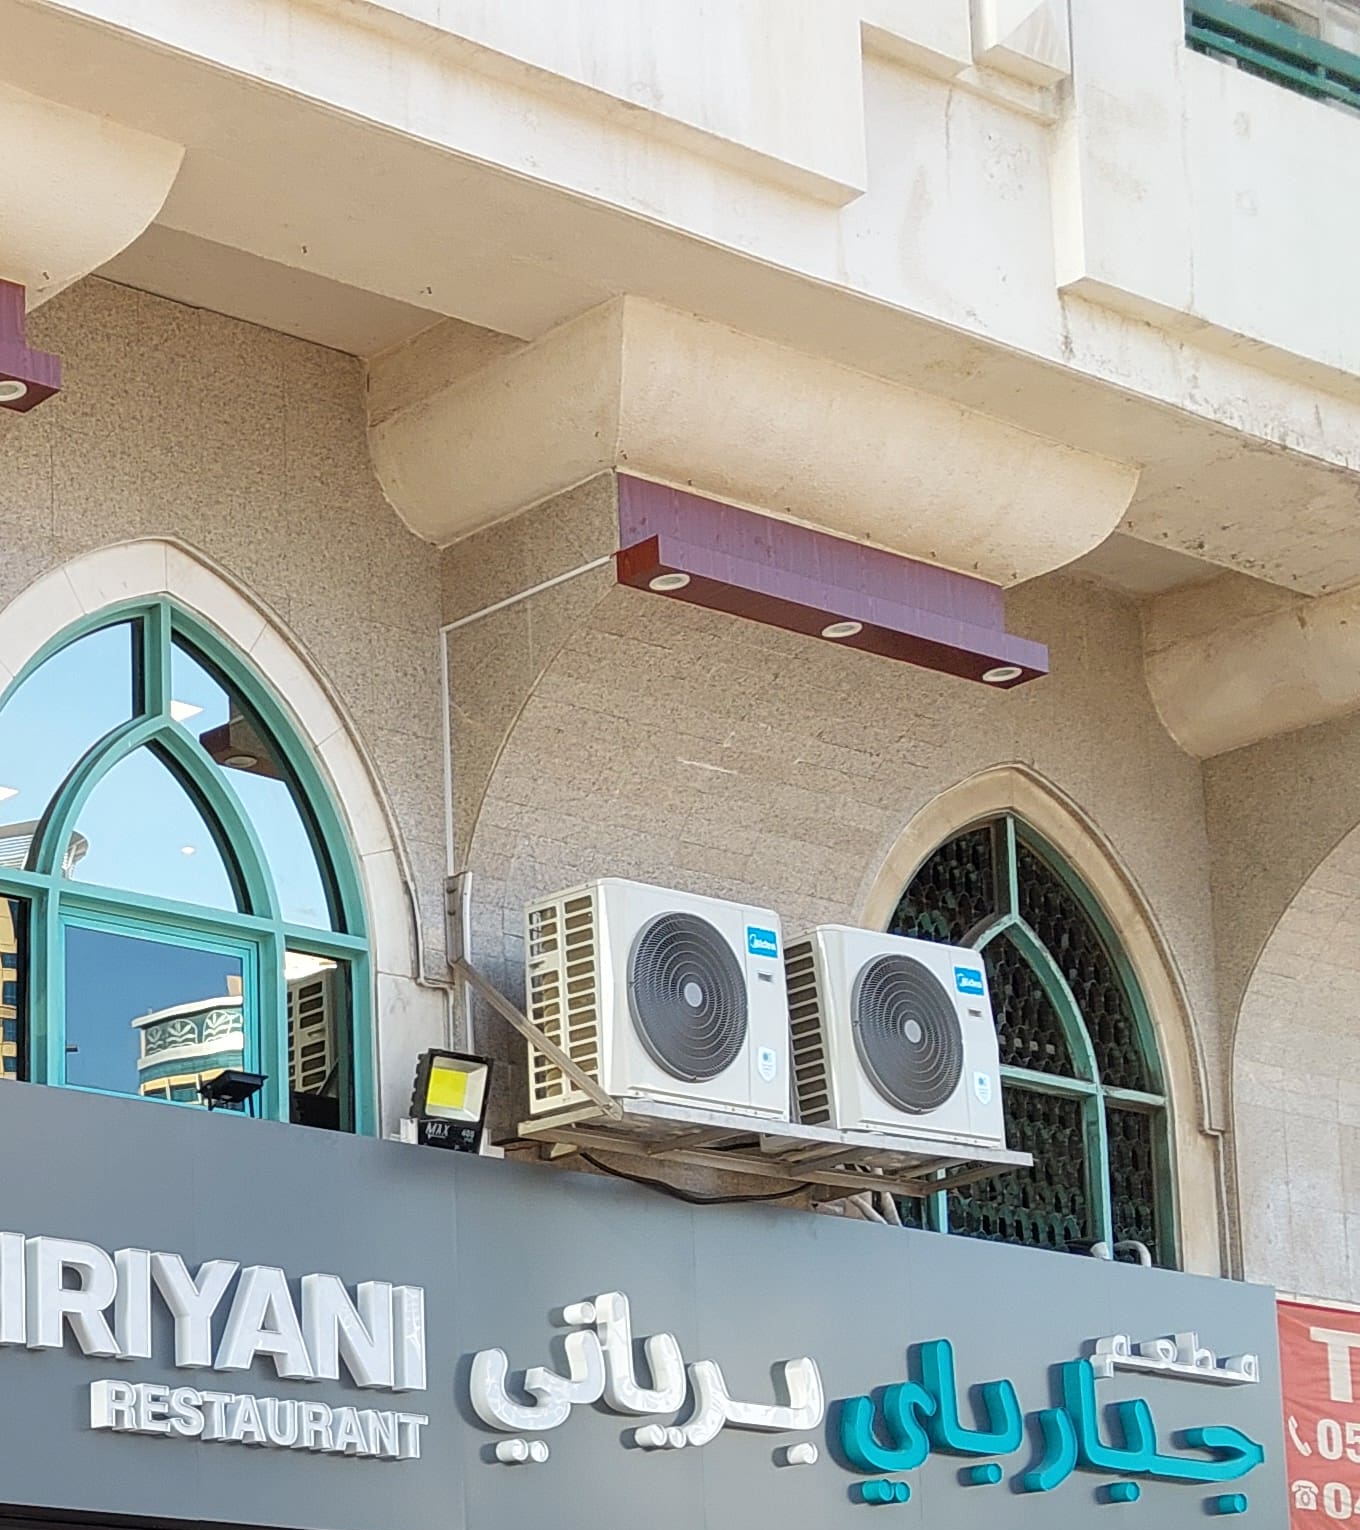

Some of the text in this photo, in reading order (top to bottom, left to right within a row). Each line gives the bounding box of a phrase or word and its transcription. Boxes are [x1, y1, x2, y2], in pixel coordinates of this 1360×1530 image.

[1091, 1331, 1260, 1387] مطعم
[90, 1379, 429, 1462] RESTAURANT
[840, 1338, 1022, 1505] باي
[1024, 1359, 1265, 1517] جبار
